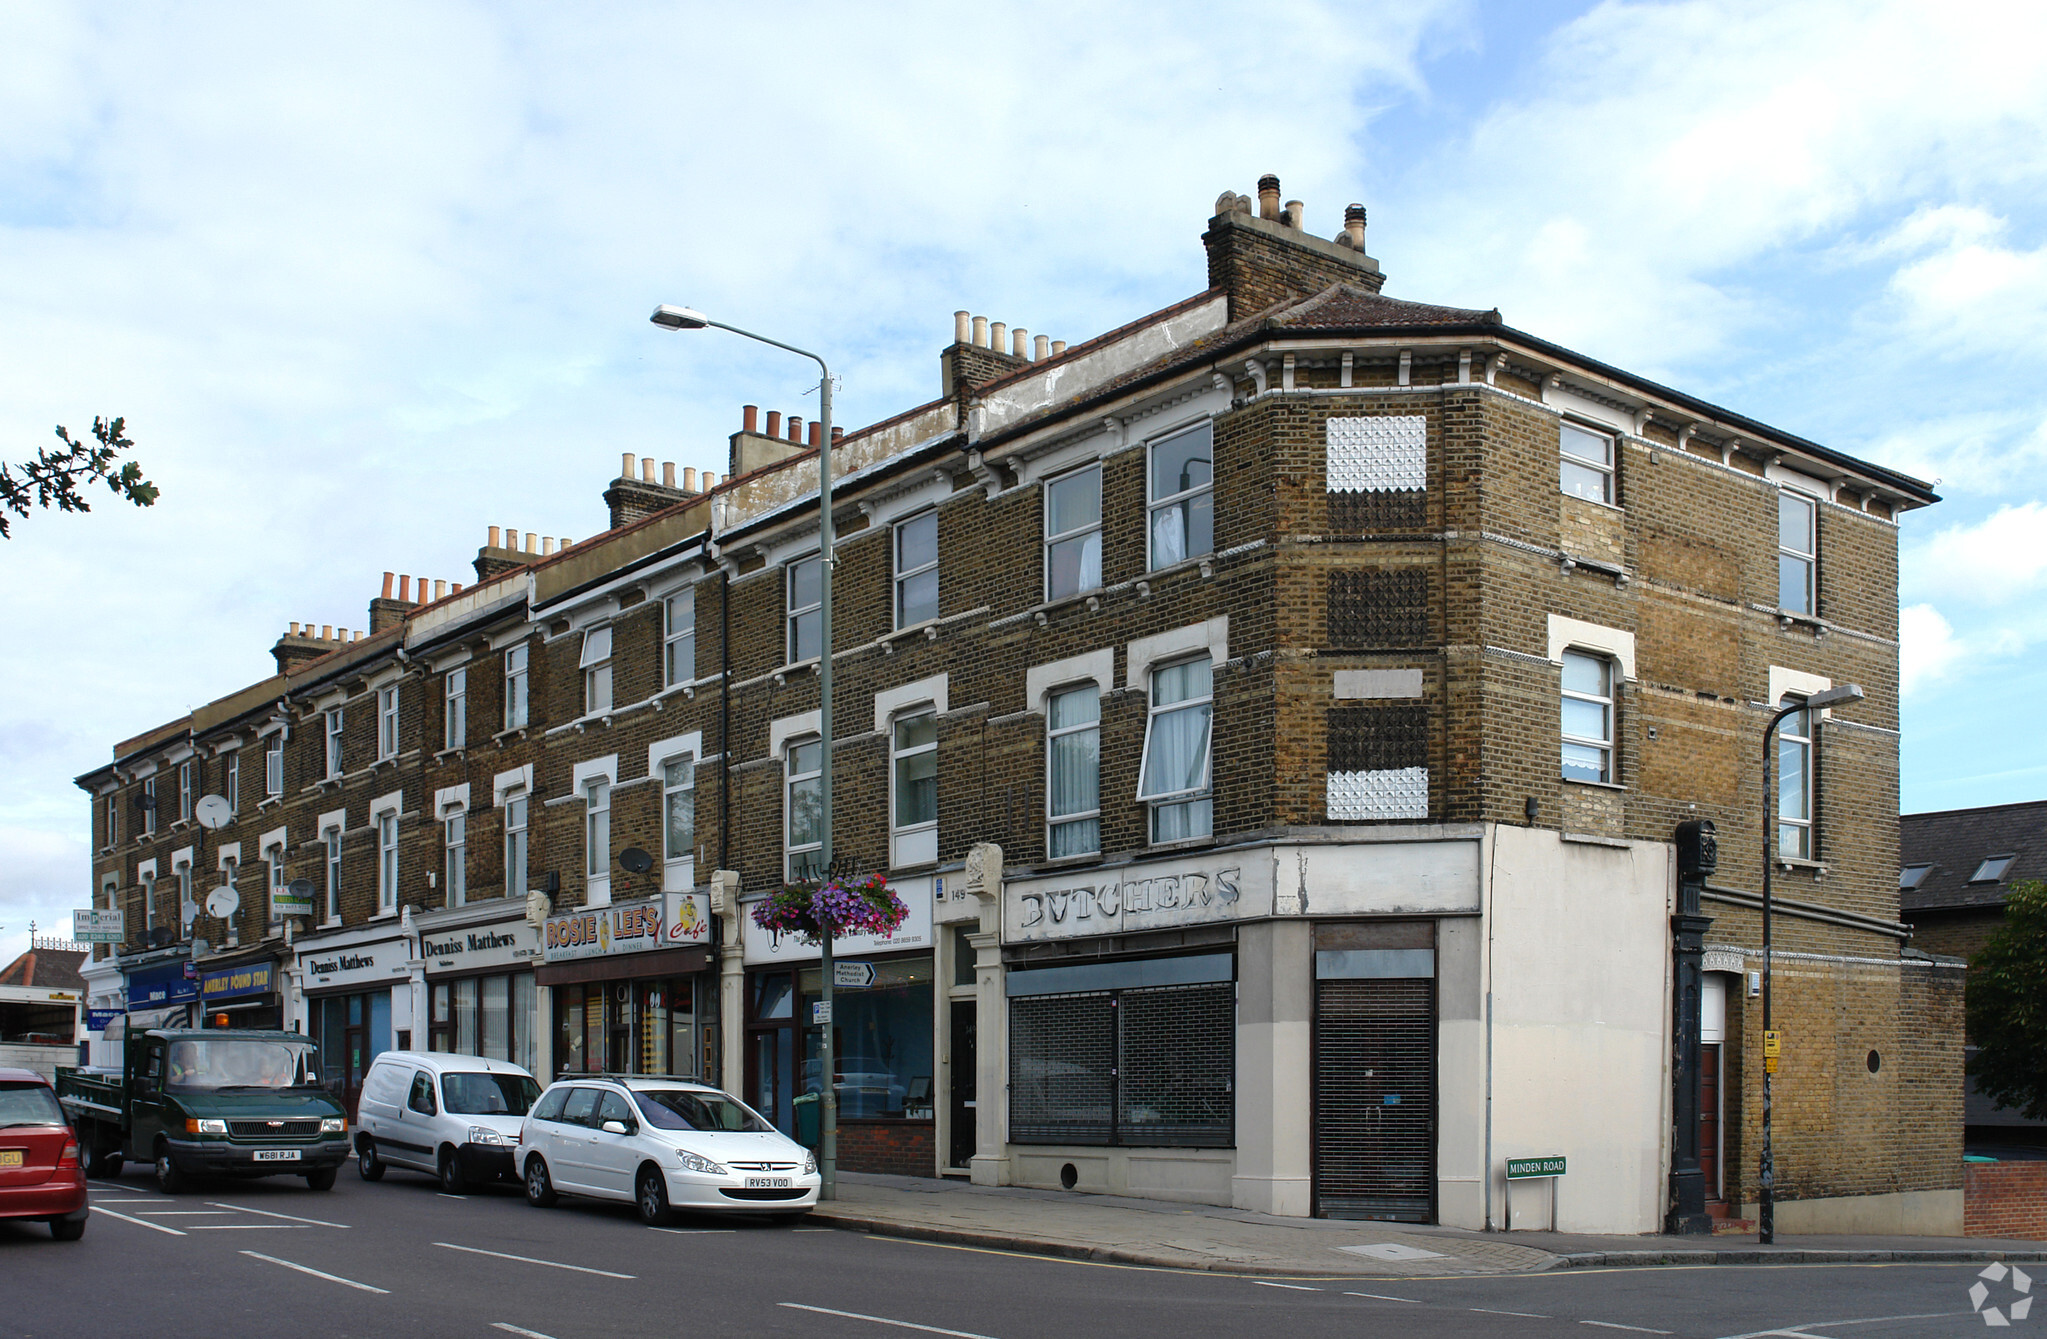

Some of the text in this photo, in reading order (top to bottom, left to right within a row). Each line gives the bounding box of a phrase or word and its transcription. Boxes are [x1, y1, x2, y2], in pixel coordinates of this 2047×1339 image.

[951, 889, 966, 901] 149
[77, 912, 121, 924] Imperial
[546, 916, 598, 949] ROSIE
[613, 906, 658, 940] LEE'S
[425, 931, 516, 957] Denniss Matthews
[622, 942, 643, 953] DINNER
[310, 953, 374, 975] Denniss Matthews
[230, 973, 252, 990] POUND
[253, 970, 268, 987] STAR
[149, 990, 166, 1001] Mace
[92, 1011, 120, 1019] Mace
[1510, 1160, 1565, 1174] MINDEN ROAD
[750, 1178, 771, 1187] RV53
